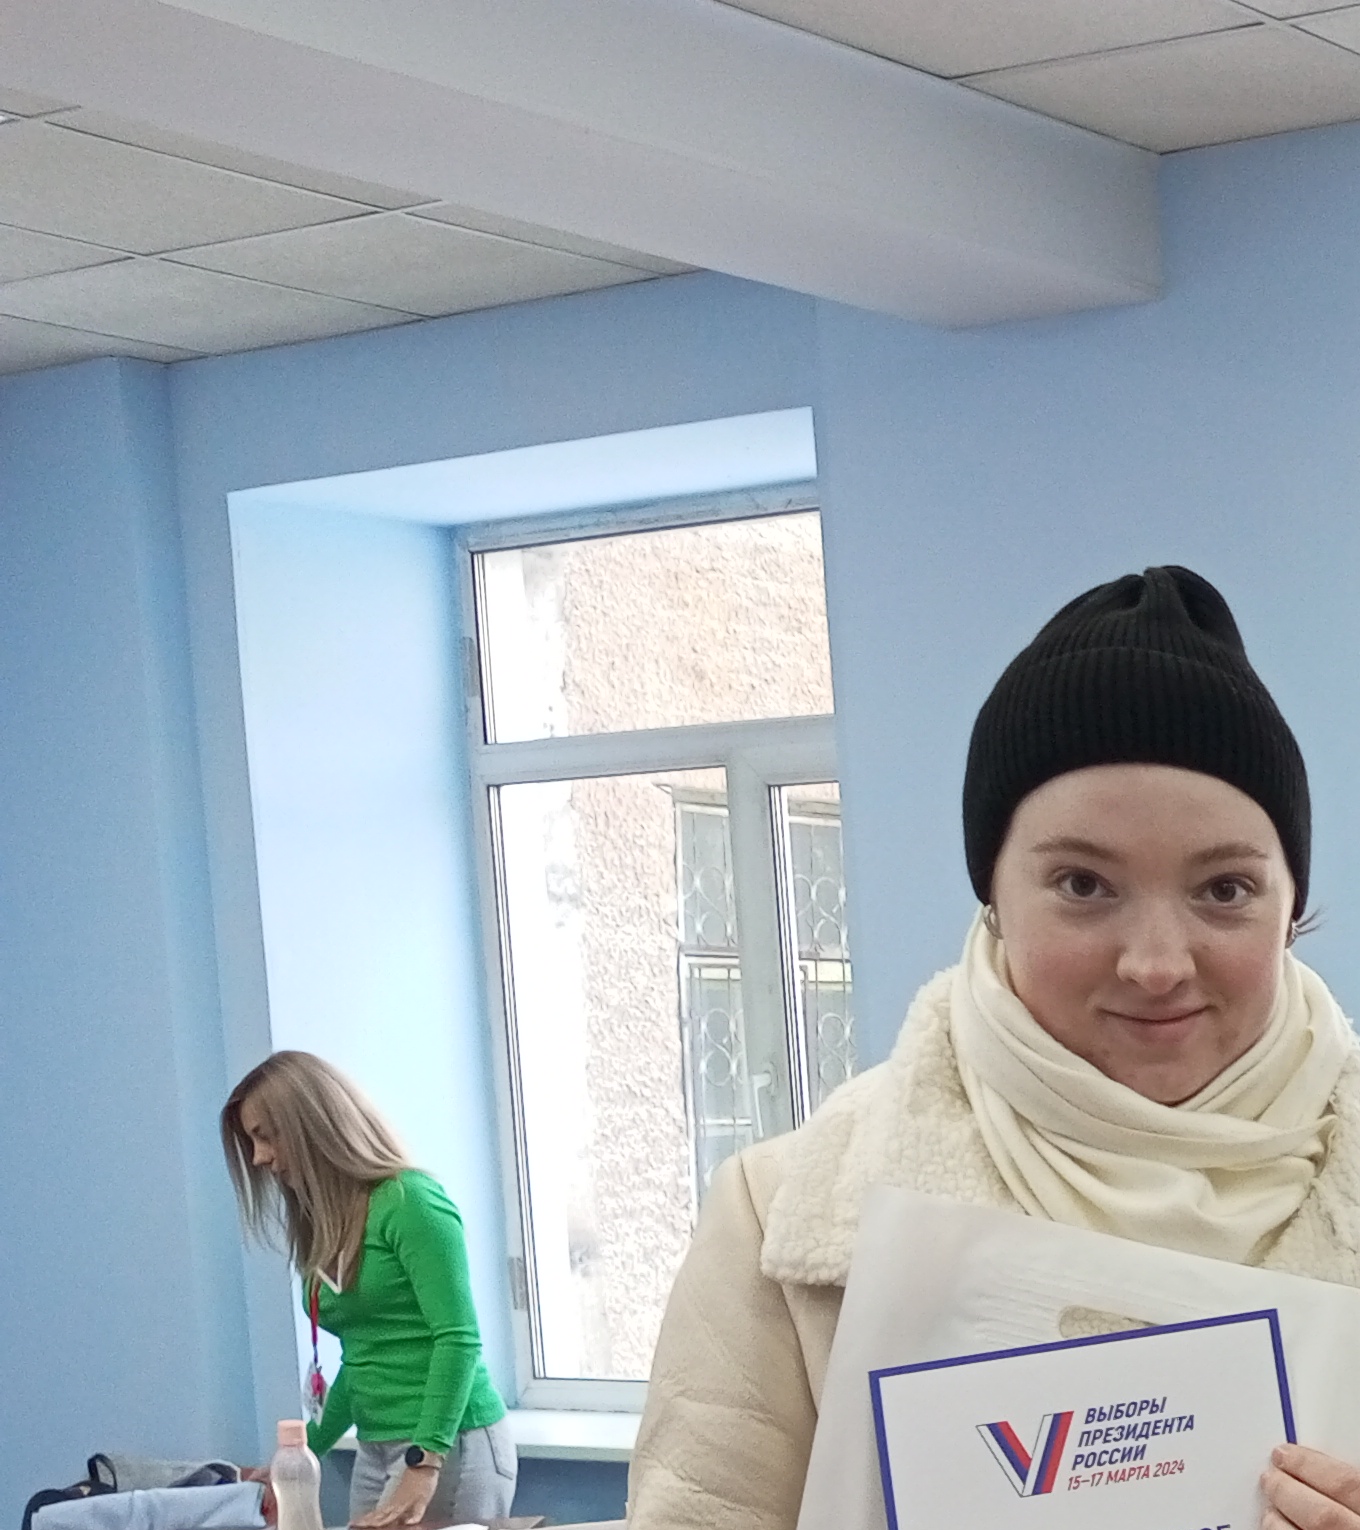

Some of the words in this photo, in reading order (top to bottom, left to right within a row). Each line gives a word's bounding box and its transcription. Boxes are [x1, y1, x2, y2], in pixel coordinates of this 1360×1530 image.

[1083, 1395, 1167, 1424] ВЫБОРЫ
[1077, 1413, 1194, 1448] ПРЕЗИДЕНТА
[1070, 1443, 1147, 1471] РОССИИ
[1105, 1464, 1150, 1485] МАРТА
[1152, 1458, 1184, 1477] 2024
